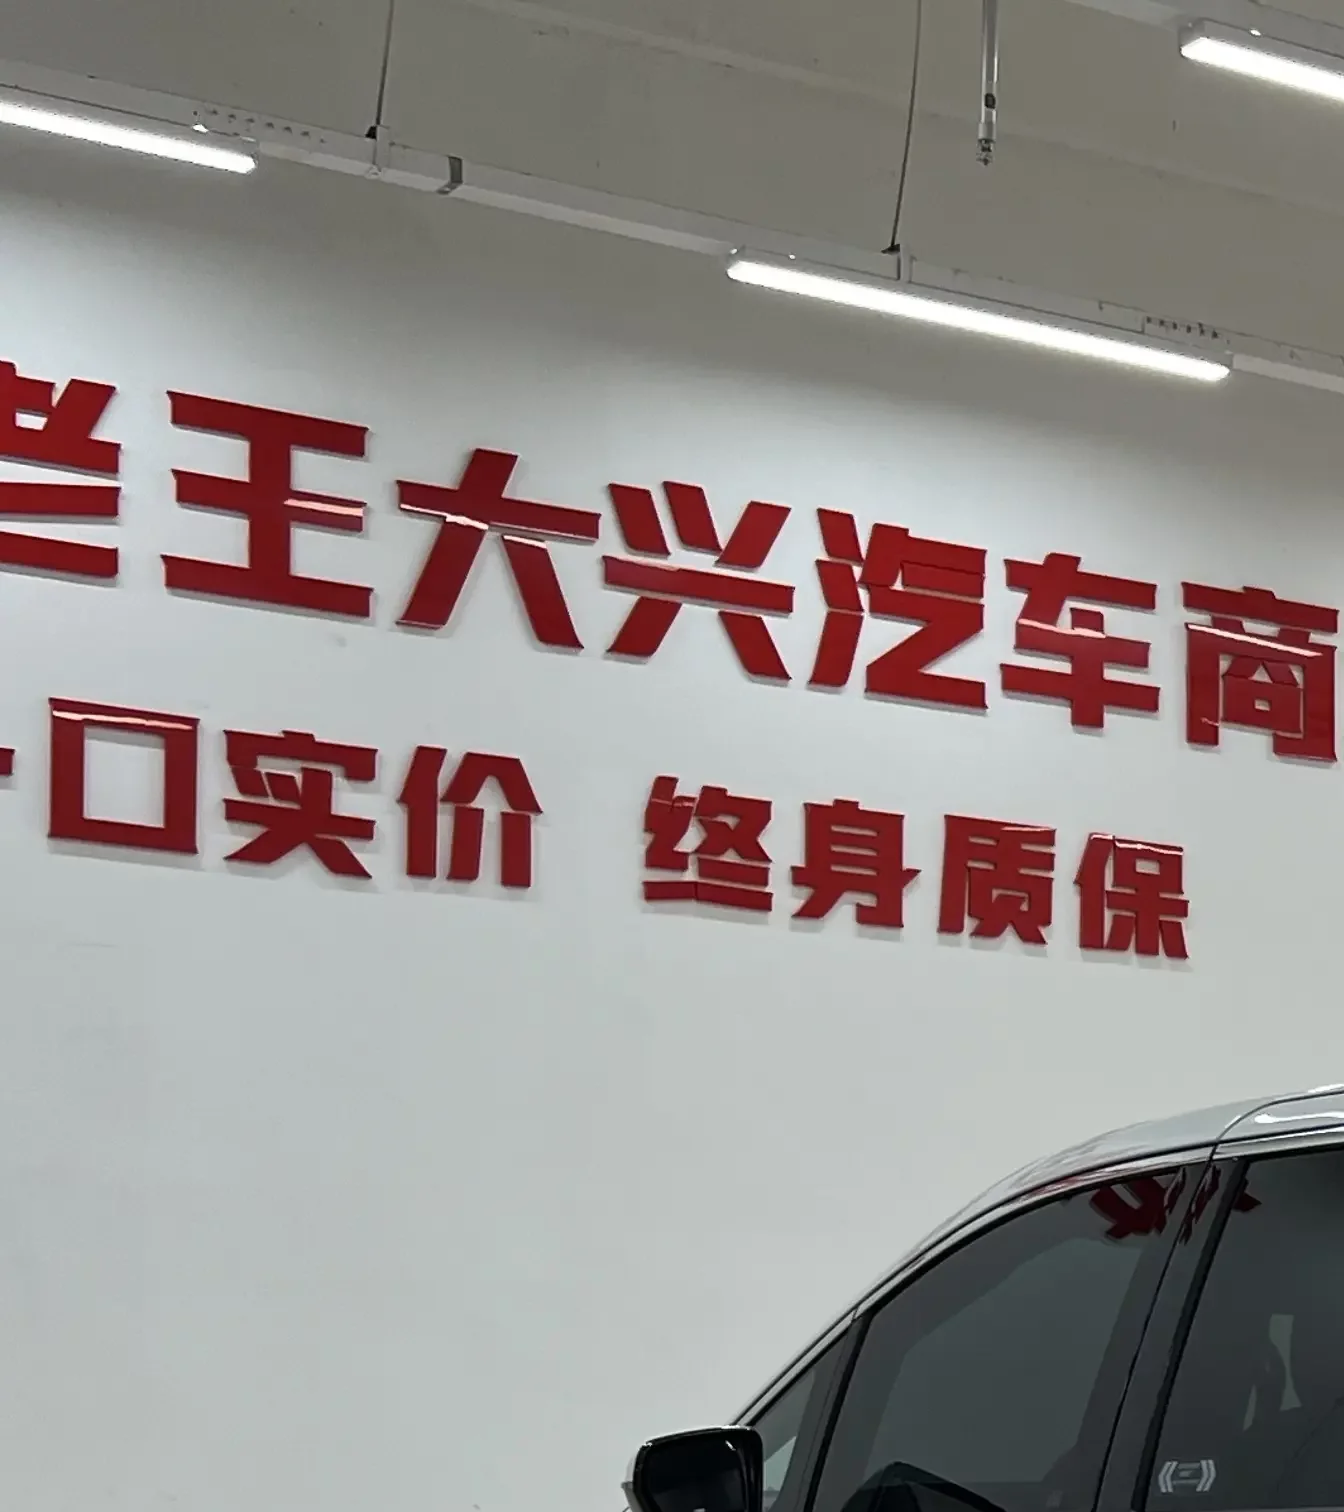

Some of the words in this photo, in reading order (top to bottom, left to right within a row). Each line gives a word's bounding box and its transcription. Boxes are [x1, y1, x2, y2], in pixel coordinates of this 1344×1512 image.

[0, 696, 543, 890] 口实价
[641, 773, 1192, 961] 终身质保
